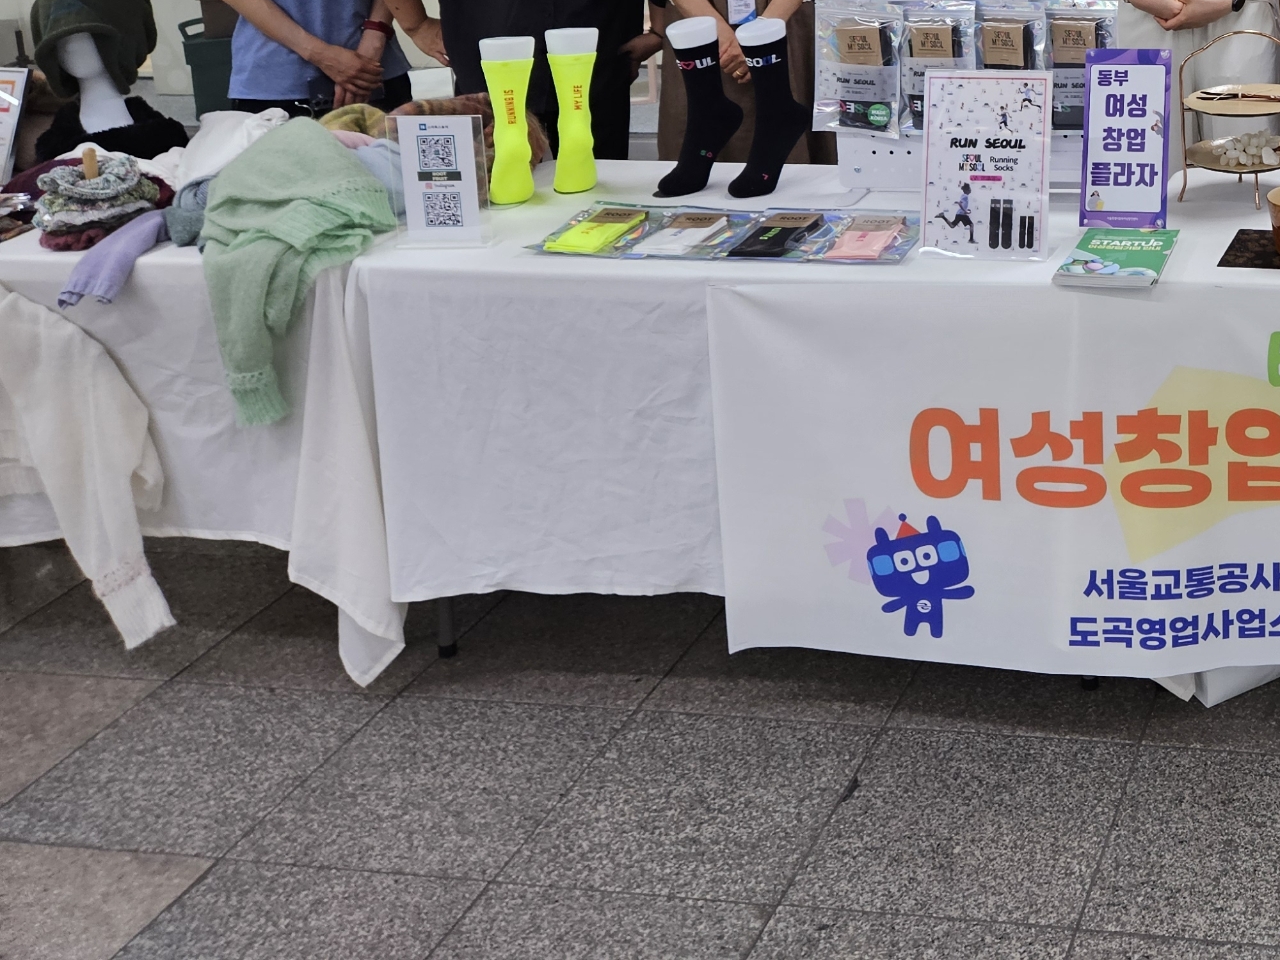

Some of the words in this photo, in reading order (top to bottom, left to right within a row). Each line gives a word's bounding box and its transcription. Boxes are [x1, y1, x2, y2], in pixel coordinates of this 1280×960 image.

[836, 76, 850, 84] RUN
[853, 78, 876, 86] SEOUL
[1097, 69, 1129, 87] 동부
[573, 84, 583, 100] LIFE
[504, 97, 517, 124] RUNNING
[574, 100, 582, 111] MY
[1105, 93, 1148, 118] 여성
[950, 137, 978, 149] RUN
[984, 138, 1026, 150] SEOUL
[1102, 126, 1146, 152] 창업
[989, 155, 1018, 166] Running
[993, 164, 1014, 172] Socks
[1090, 162, 1158, 187] 플라자
[1090, 238, 1164, 247] STARTUP
